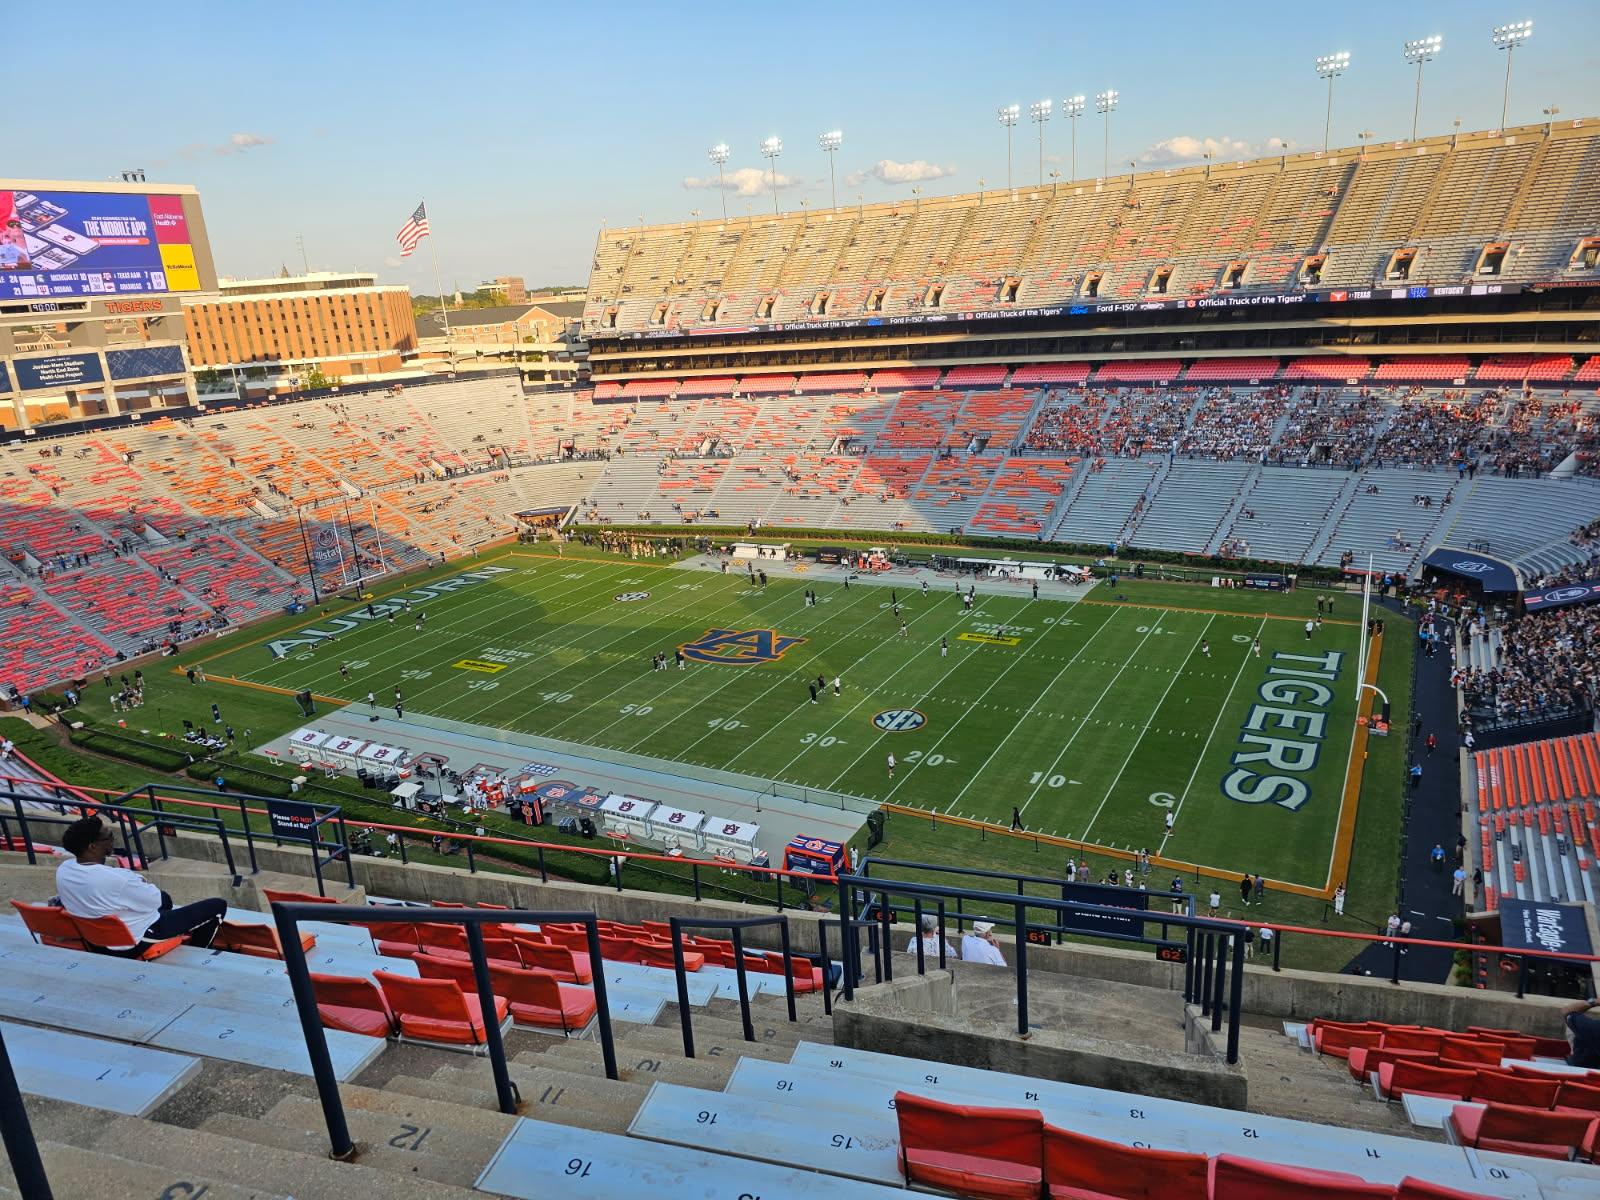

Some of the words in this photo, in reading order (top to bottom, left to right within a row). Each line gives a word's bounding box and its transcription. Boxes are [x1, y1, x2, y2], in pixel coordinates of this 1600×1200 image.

[83, 221, 101, 236] THE
[100, 221, 131, 236] MOBILE
[130, 221, 147, 236] APP
[1354, 291, 1371, 299] TEXAS
[1434, 286, 1464, 296] KENTUCKY
[105, 301, 163, 313] TIGERS
[1199, 299, 1227, 308] Official
[1228, 297, 1250, 306] Truck
[1251, 296, 1260, 304] of
[1261, 295, 1275, 304] the
[1277, 294, 1303, 305] Tigers
[975, 312, 999, 320] Official
[1000, 310, 1018, 318] Truck
[1018, 309, 1027, 317] of
[1027, 308, 1039, 316] the
[1039, 308, 1061, 317] Tigers
[1096, 305, 1113, 313] Ford
[784, 323, 805, 331] Official
[830, 320, 840, 328] the
[65, 371, 84, 379] Project
[266, 565, 516, 660] AUBURN
[1043, 617, 1075, 626] 20
[1135, 626, 1164, 635] 10
[1231, 634, 1251, 643] G
[468, 680, 500, 691] 30
[543, 692, 574, 703] 40
[619, 703, 654, 716] 50
[707, 717, 741, 731] 40
[875, 710, 925, 731] SEC
[1220, 651, 1346, 812] TIGERS
[800, 733, 837, 748] 30
[903, 750, 944, 767] 20
[1029, 771, 1066, 788] 10
[1148, 792, 1176, 808] G
[272, 813, 290, 821] Please
[277, 820, 293, 828] Stand
[1029, 931, 1046, 943] 61
[1161, 950, 1181, 961] 62
[117, 1009, 132, 1019] 3
[218, 1029, 235, 1040] 2
[95, 1068, 112, 1082] 1
[776, 1079, 795, 1092] 16
[539, 1086, 565, 1105] 11
[829, 1060, 844, 1068] 16
[924, 1075, 940, 1085] 15
[1025, 1091, 1040, 1101] 14
[1129, 1108, 1146, 1120] 13
[1242, 1127, 1260, 1139] 12
[1365, 1148, 1381, 1159] 11
[1489, 1166, 1511, 1180] 10
[696, 1110, 719, 1126] 16
[830, 1133, 853, 1150] 15
[388, 1124, 432, 1151] 12
[564, 1157, 593, 1179] 16
